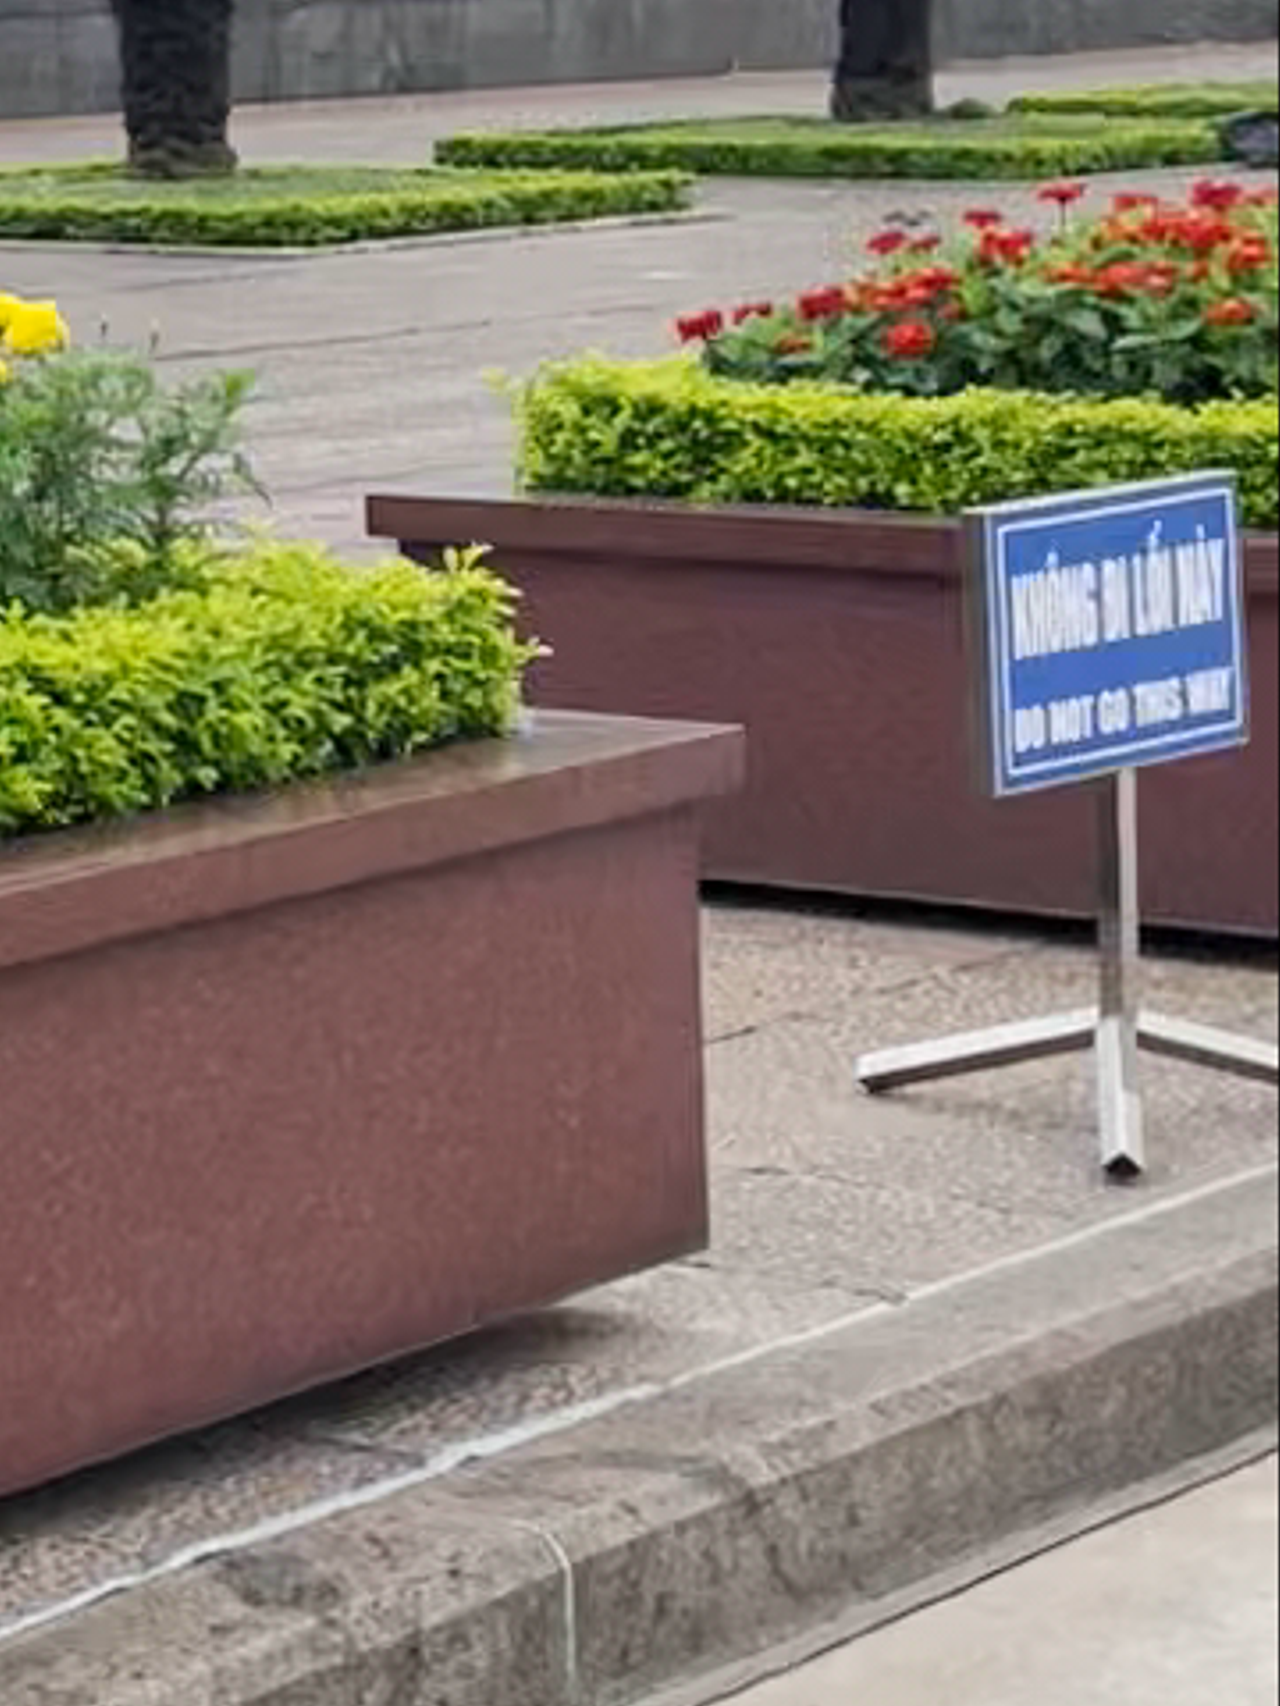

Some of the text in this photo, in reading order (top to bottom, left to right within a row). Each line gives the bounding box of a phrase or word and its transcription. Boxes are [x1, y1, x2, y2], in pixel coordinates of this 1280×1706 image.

[1014, 705, 1045, 753] DO
[1049, 695, 1094, 744] NOT
[1098, 688, 1131, 733] GO
[1133, 677, 1182, 726] THIS
